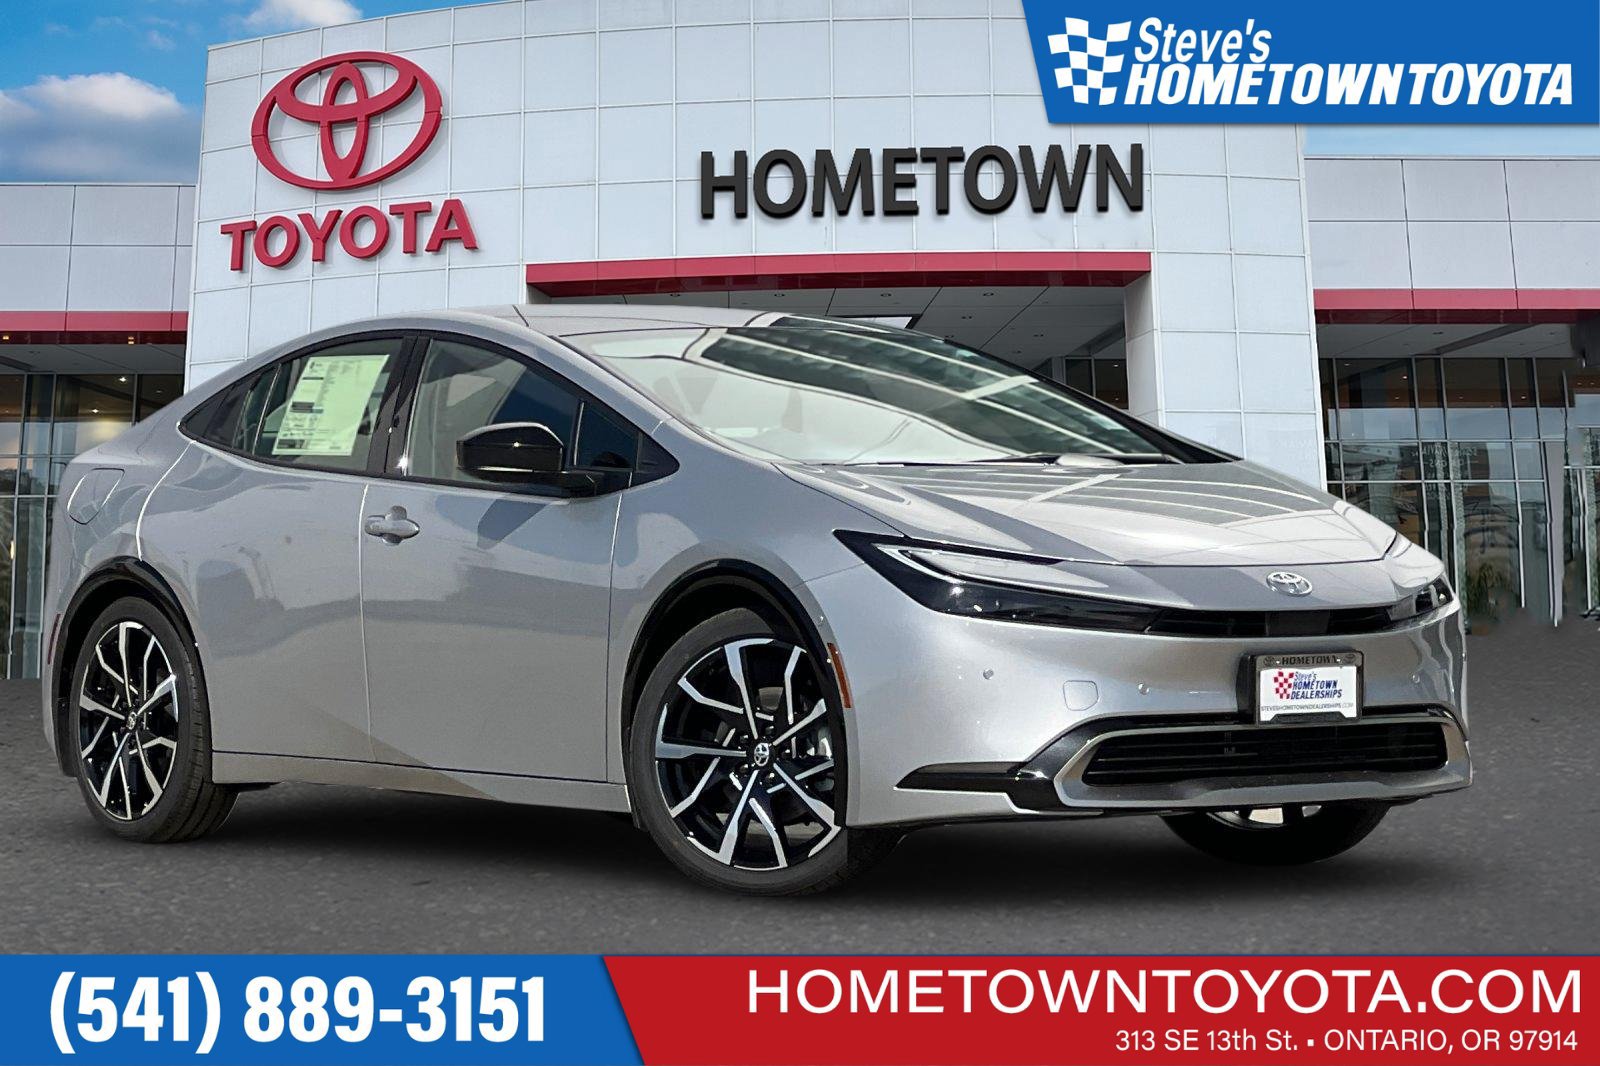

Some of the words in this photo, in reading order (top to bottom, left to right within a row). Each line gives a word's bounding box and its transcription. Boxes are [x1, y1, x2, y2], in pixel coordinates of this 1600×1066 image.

[700, 143, 1145, 220] HOMETOWN
[221, 198, 478, 271] TOYOTA
[1281, 655, 1338, 665] HOMETOWN
[1292, 680, 1338, 690] HOMETOWN
[1290, 689, 1342, 700] DEALERSHIPS
